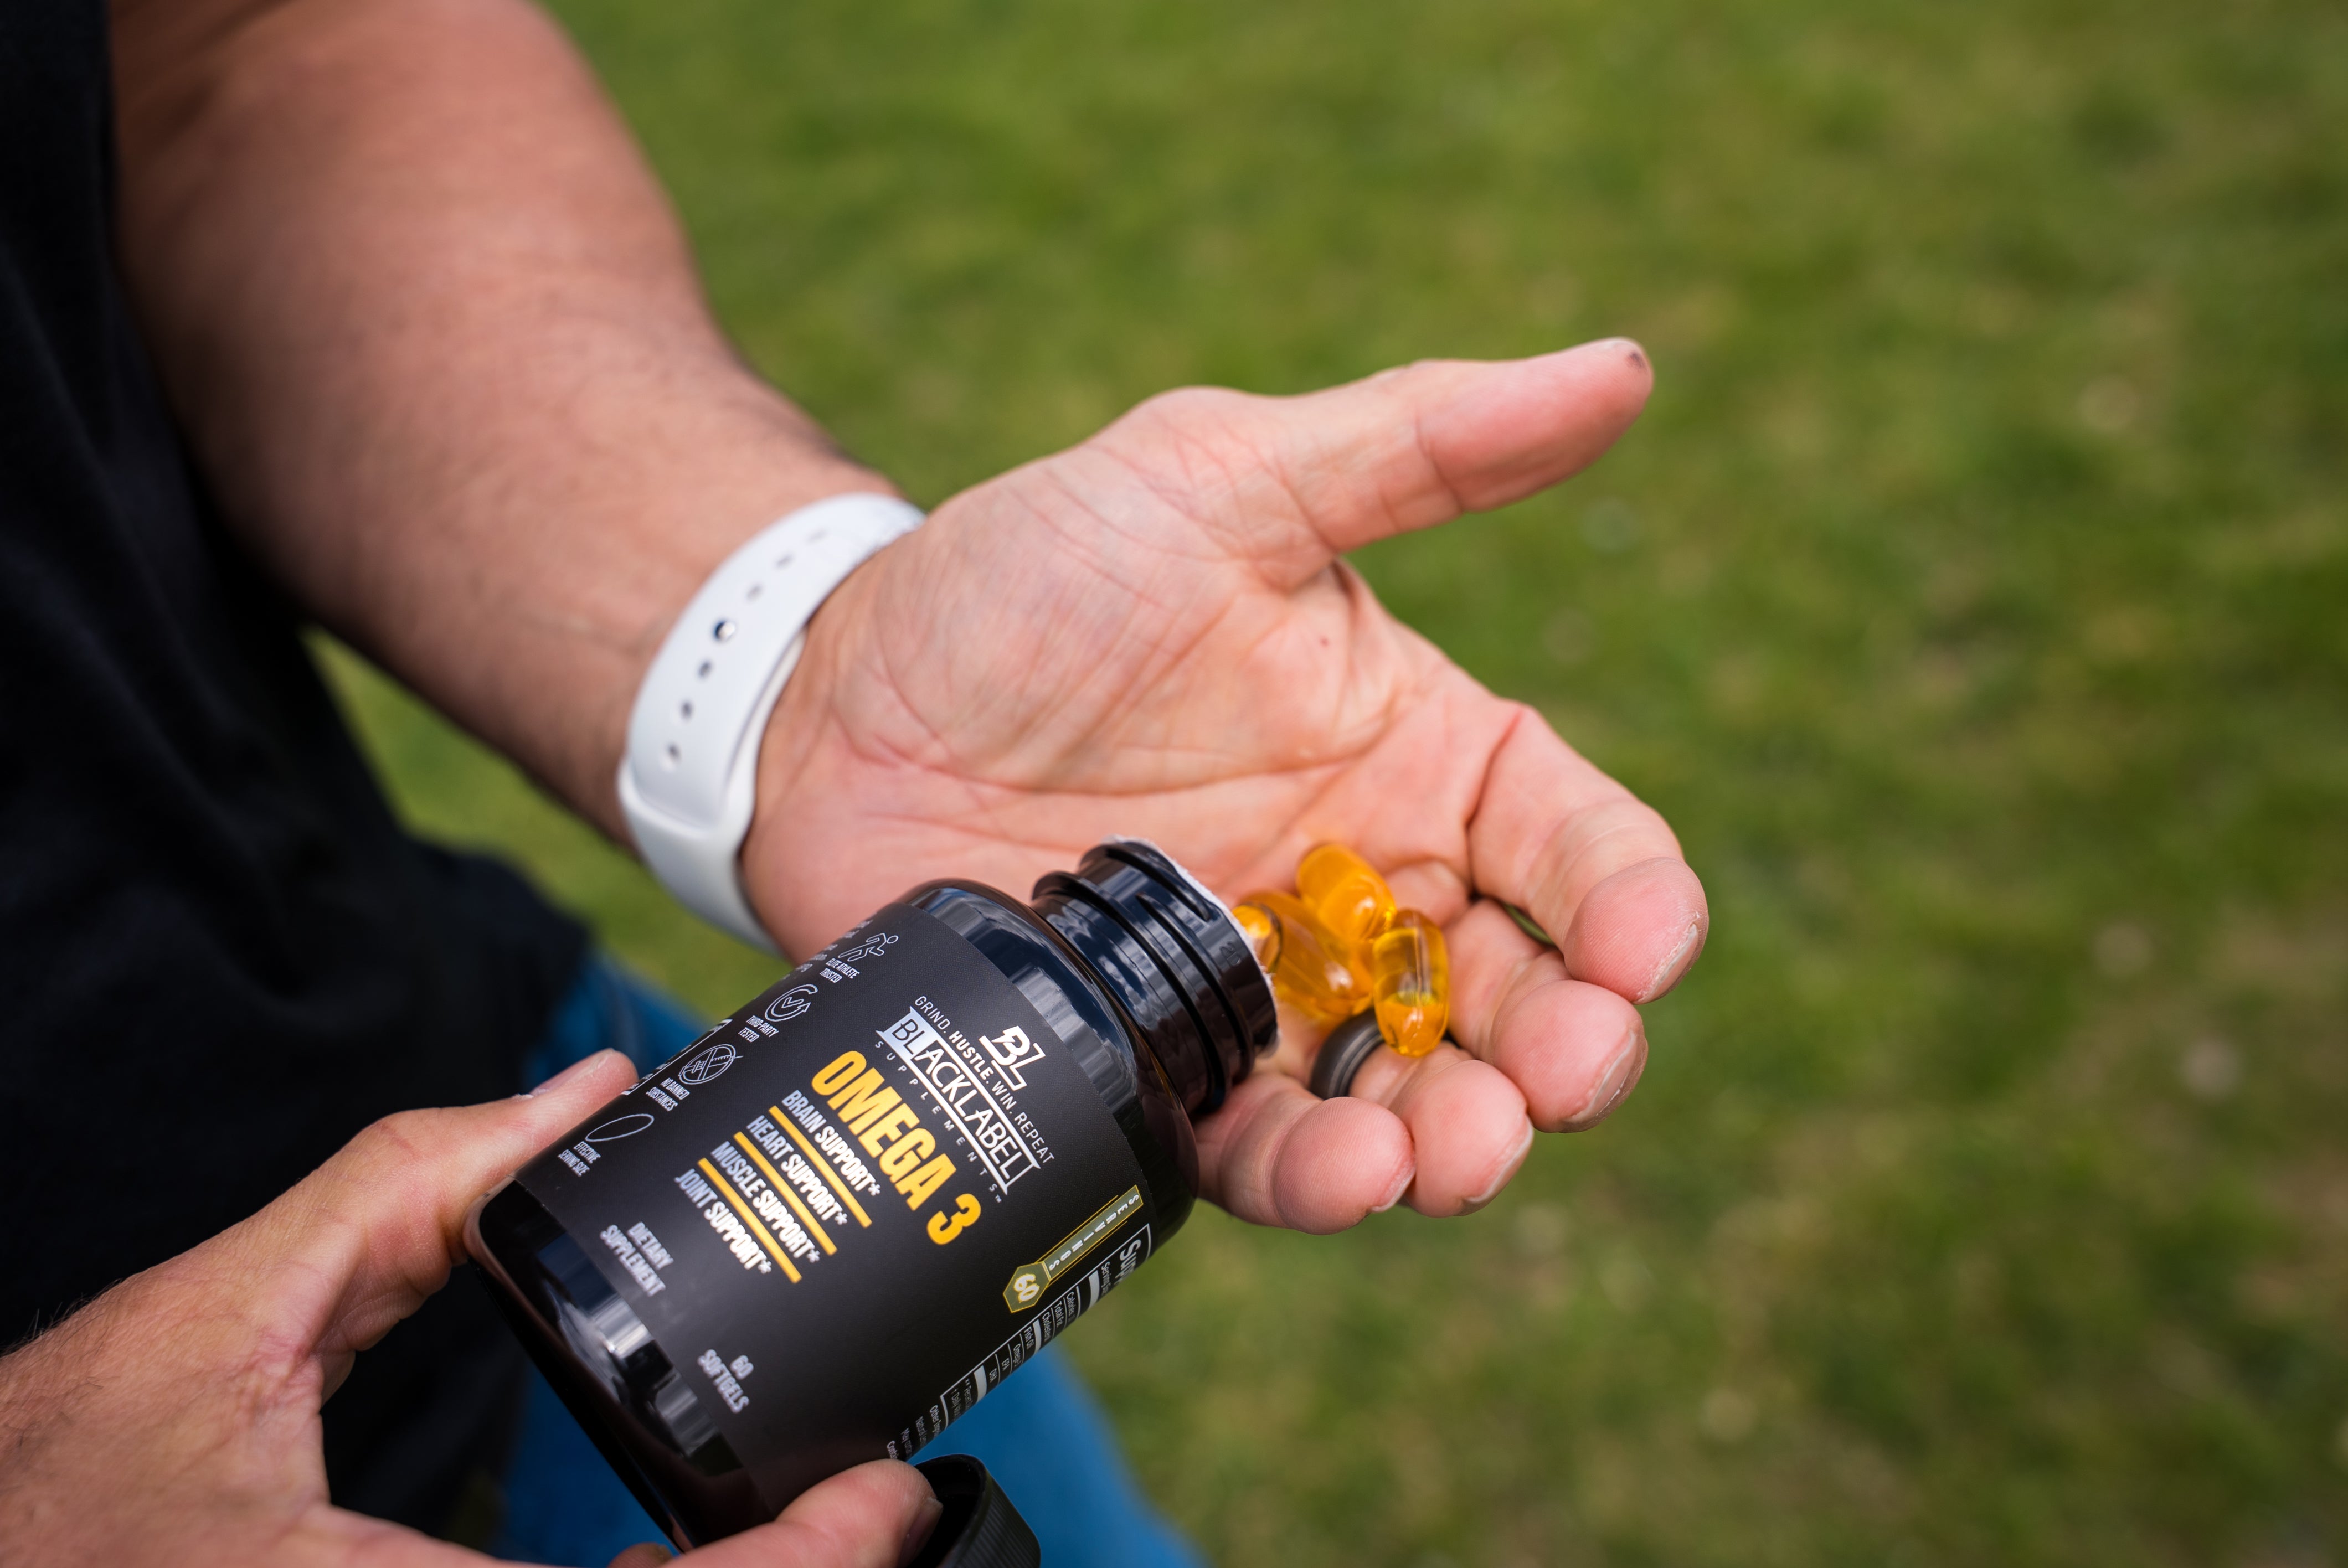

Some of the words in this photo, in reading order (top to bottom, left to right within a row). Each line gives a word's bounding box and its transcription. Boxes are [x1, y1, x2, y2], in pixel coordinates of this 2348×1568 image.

[819, 968, 843, 983] TRUSTED
[826, 958, 842, 968] ELITE
[836, 963, 860, 979] ATHLETE
[738, 1027, 760, 1043] TESTED
[746, 1015, 779, 1038] THIRD-PARTY
[660, 1077, 671, 1087] NO
[665, 1081, 690, 1100] BANNED
[914, 996, 951, 1034] GRIND.
[949, 1031, 994, 1084] HUSTLE.
[991, 1081, 1017, 1114] WIN.
[1014, 1112, 1054, 1163] REPEAT
[645, 1086, 678, 1111] SUBSTANCES
[892, 1018, 1023, 1180] BLACKLABEL
[781, 1090, 827, 1134] BRAIN
[745, 1115, 794, 1160] HEART
[811, 1050, 957, 1211] OMEGA
[926, 1193, 981, 1245] 3
[573, 1141, 601, 1164] EFFECTIVE
[572, 1161, 590, 1177] SIZE
[710, 1141, 767, 1199] MUSCLE
[673, 1168, 718, 1209] JOINT
[1049, 1194, 1139, 1271] SERVINGS
[626, 1221, 674, 1270] DIETARY
[600, 1224, 666, 1297] SUPPLEMENT
[1101, 1261, 1111, 1288] Serving
[1013, 1273, 1041, 1303] 60
[1054, 1301, 1063, 1318] Total
[1067, 1291, 1075, 1316] Calories
[1024, 1326, 1033, 1342] Fish
[1027, 1339, 1035, 1349] Oil
[730, 1355, 754, 1380] 60
[989, 1368, 997, 1383] DHA
[1002, 1358, 1010, 1371] EPA
[697, 1349, 749, 1413] SOFTGELS
[951, 1392, 961, 1409] Daily
[930, 1405, 939, 1423] Other
[900, 1428, 910, 1443] May
[915, 1416, 927, 1437] Natural
